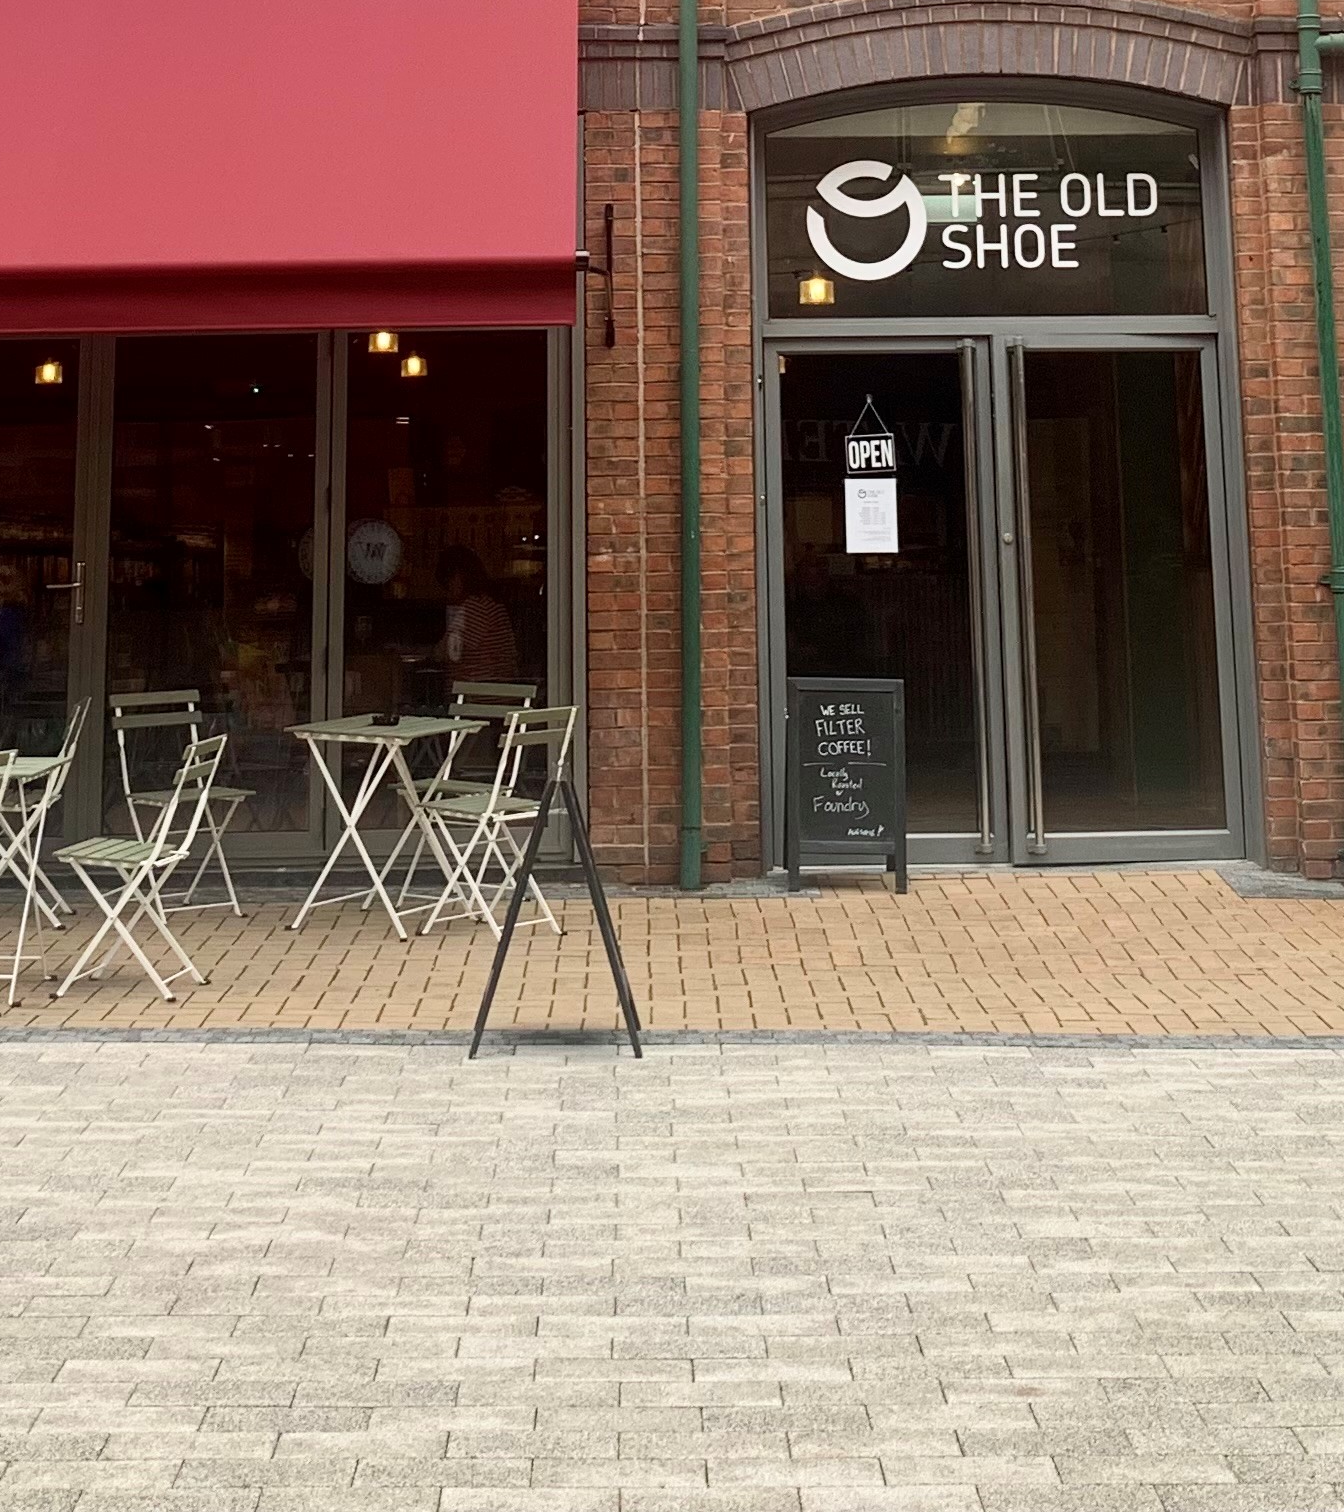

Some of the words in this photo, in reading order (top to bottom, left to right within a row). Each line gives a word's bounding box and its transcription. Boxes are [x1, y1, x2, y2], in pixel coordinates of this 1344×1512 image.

[938, 173, 1041, 218] THE
[1060, 173, 1158, 217] OLD
[941, 223, 1080, 269] SHOE
[847, 439, 894, 470] OPEN
[819, 704, 836, 716] WE
[838, 703, 865, 716] SELL
[815, 718, 866, 737] FILTER
[817, 739, 872, 757] COFFEE!
[813, 795, 870, 820] Foundry
